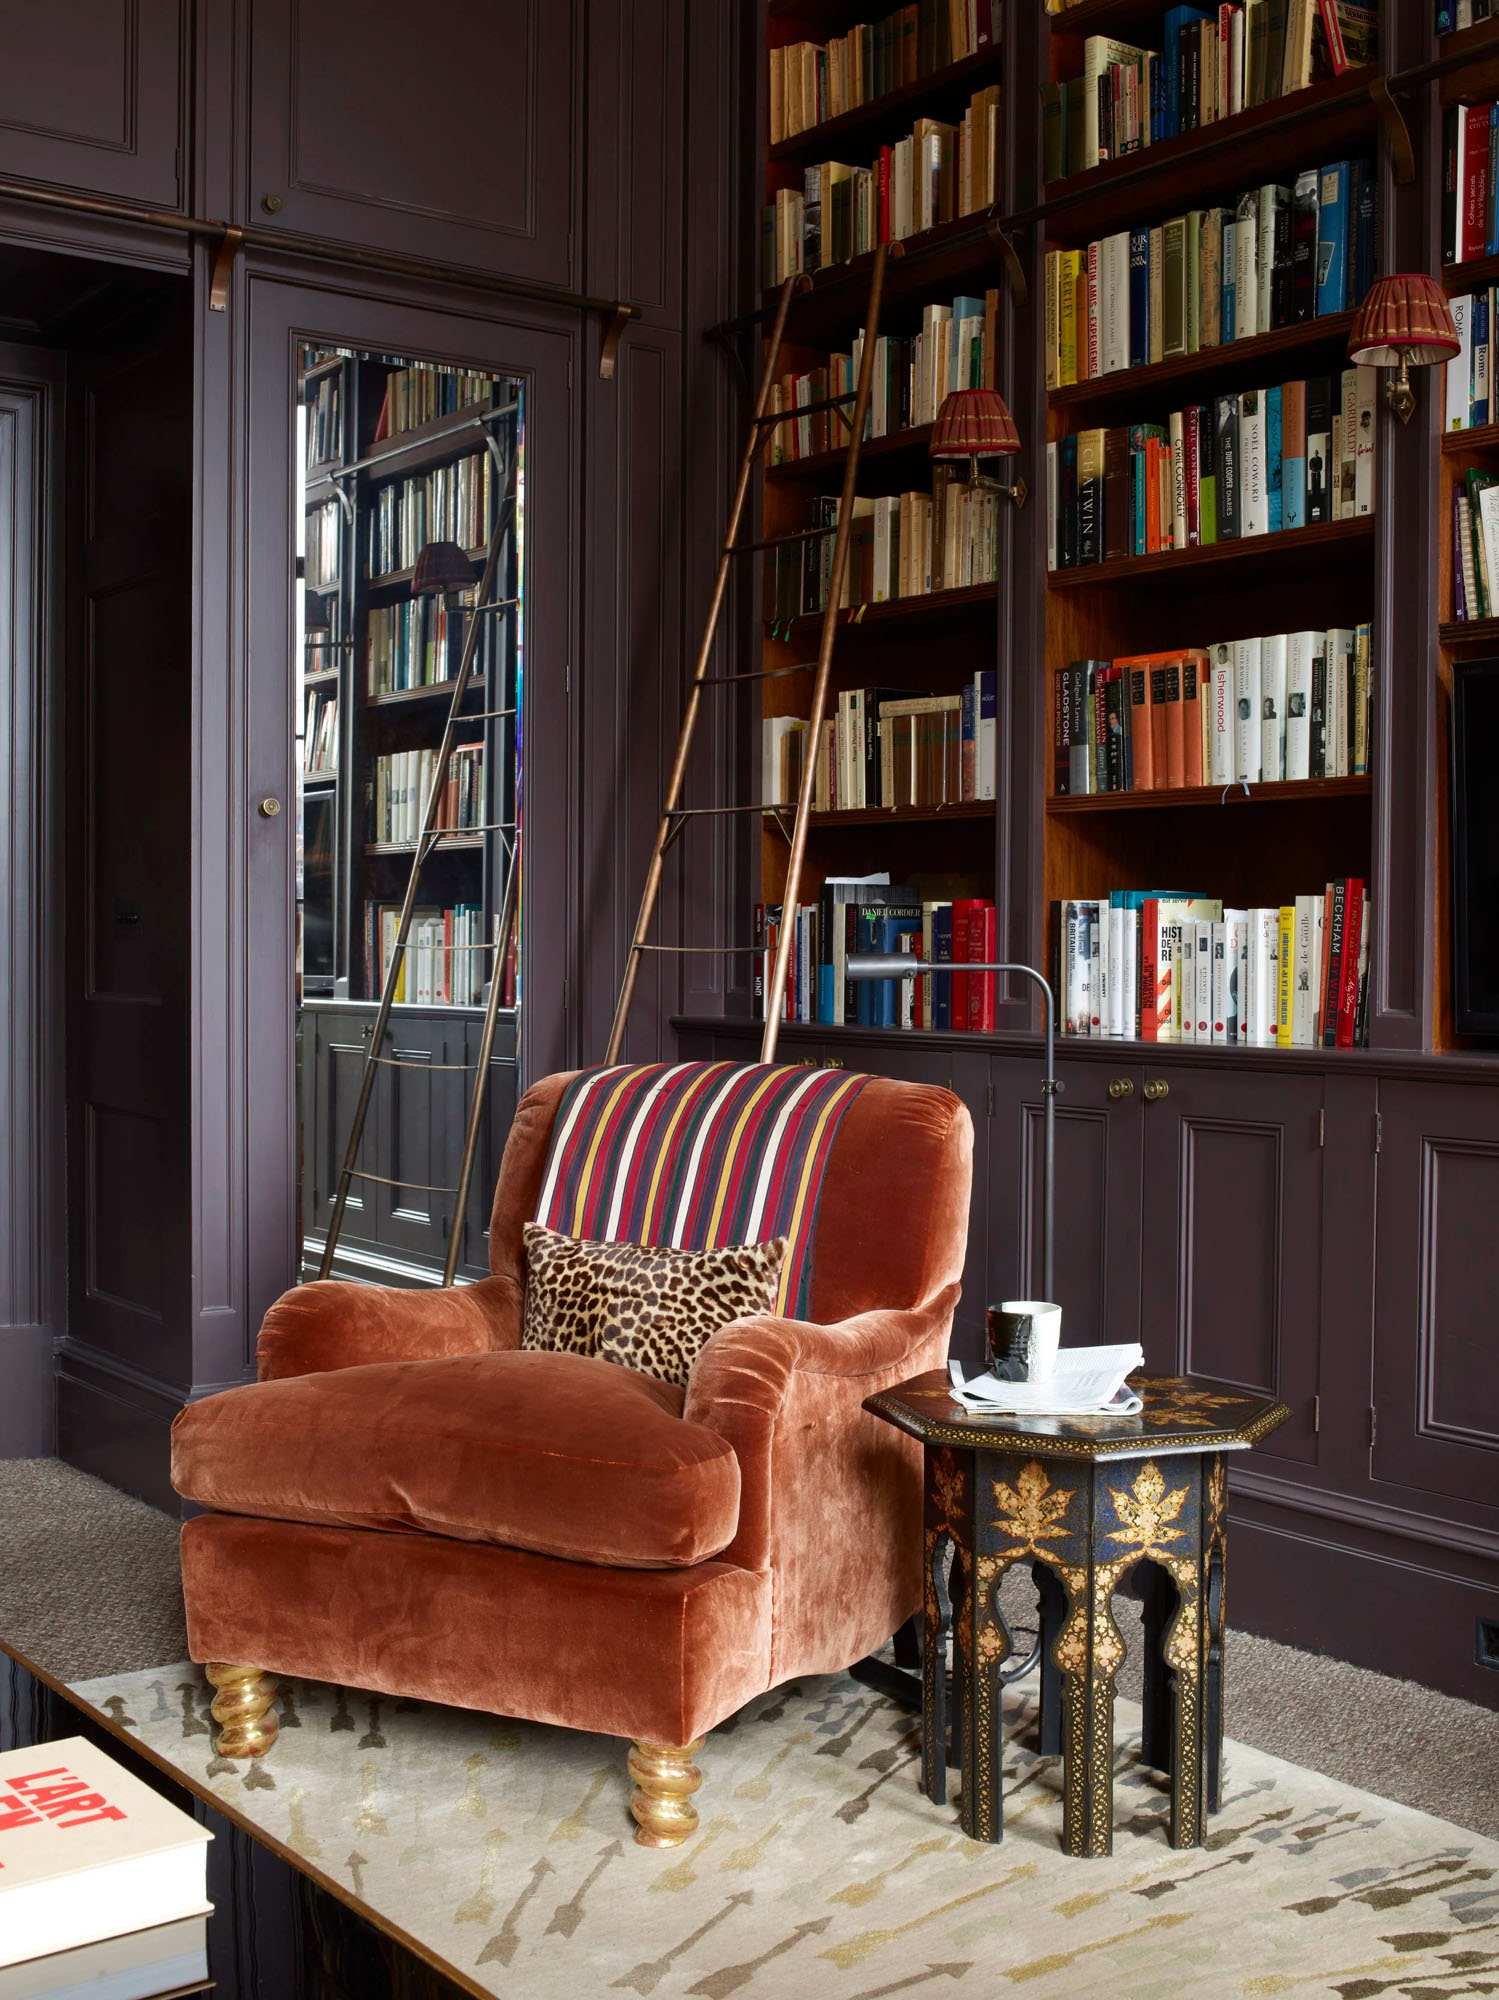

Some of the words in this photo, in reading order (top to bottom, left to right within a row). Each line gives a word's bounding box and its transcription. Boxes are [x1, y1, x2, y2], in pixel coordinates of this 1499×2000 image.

[1477, 168, 1486, 202] République
[1477, 218, 1484, 228] de
[1478, 209, 1484, 217] la
[1259, 225, 1269, 261] Maurice
[1088, 245, 1097, 281] MARTIN
[1259, 262, 1269, 291] Bowra
[1063, 258, 1073, 319] ACKERLEY
[1089, 284, 1097, 308] AMIS
[1110, 283, 1115, 292] OF
[1454, 305, 1464, 337] ROME
[1089, 316, 1098, 375] EXPERIENCE
[1478, 346, 1487, 379] Rome
[1189, 410, 1197, 443] CYRIL
[1347, 392, 1357, 454] GARIBALDI
[1174, 438, 1184, 467] CYRIL
[1224, 436, 1232, 450] THE
[1224, 450, 1233, 466] DUFF
[1190, 446, 1198, 502] CONNOLLY
[1224, 466, 1234, 489] COOPER
[1251, 456, 1259, 503] COWARD
[1082, 447, 1094, 534] CHATWIN
[1175, 466, 1185, 518] CONNOLLY
[1225, 489, 1233, 517] DIARIES
[1074, 672, 1082, 706] Gielgud's
[1217, 670, 1227, 733] Isherwood
[1062, 671, 1070, 747] GLADSTONE
[1098, 746, 1106, 769] Letters
[862, 907, 887, 916] DANIEL
[889, 908, 921, 917] CORDIER
[1331, 886, 1345, 954] BECKHAM
[1350, 895, 1361, 926] TOM
[1299, 912, 1309, 948] Gaulle
[1143, 955, 1149, 964] LA
[1281, 932, 1289, 968] RÉPUBLIQUE
[1300, 950, 1309, 964] de
[1143, 964, 1149, 973] DE
[1330, 956, 1339, 975] MY
[754, 976, 762, 997] MIND
[1217, 984, 1222, 992] DE
[1281, 989, 1288, 997] DE
[1282, 979, 1288, 987] LA
[1345, 978, 1355, 993] My
[1202, 994, 1207, 1005] DE
[1325, 978, 1339, 1028] WORLD
[1344, 993, 1355, 1014] Story
[5, 1767, 128, 1829] L'ART
